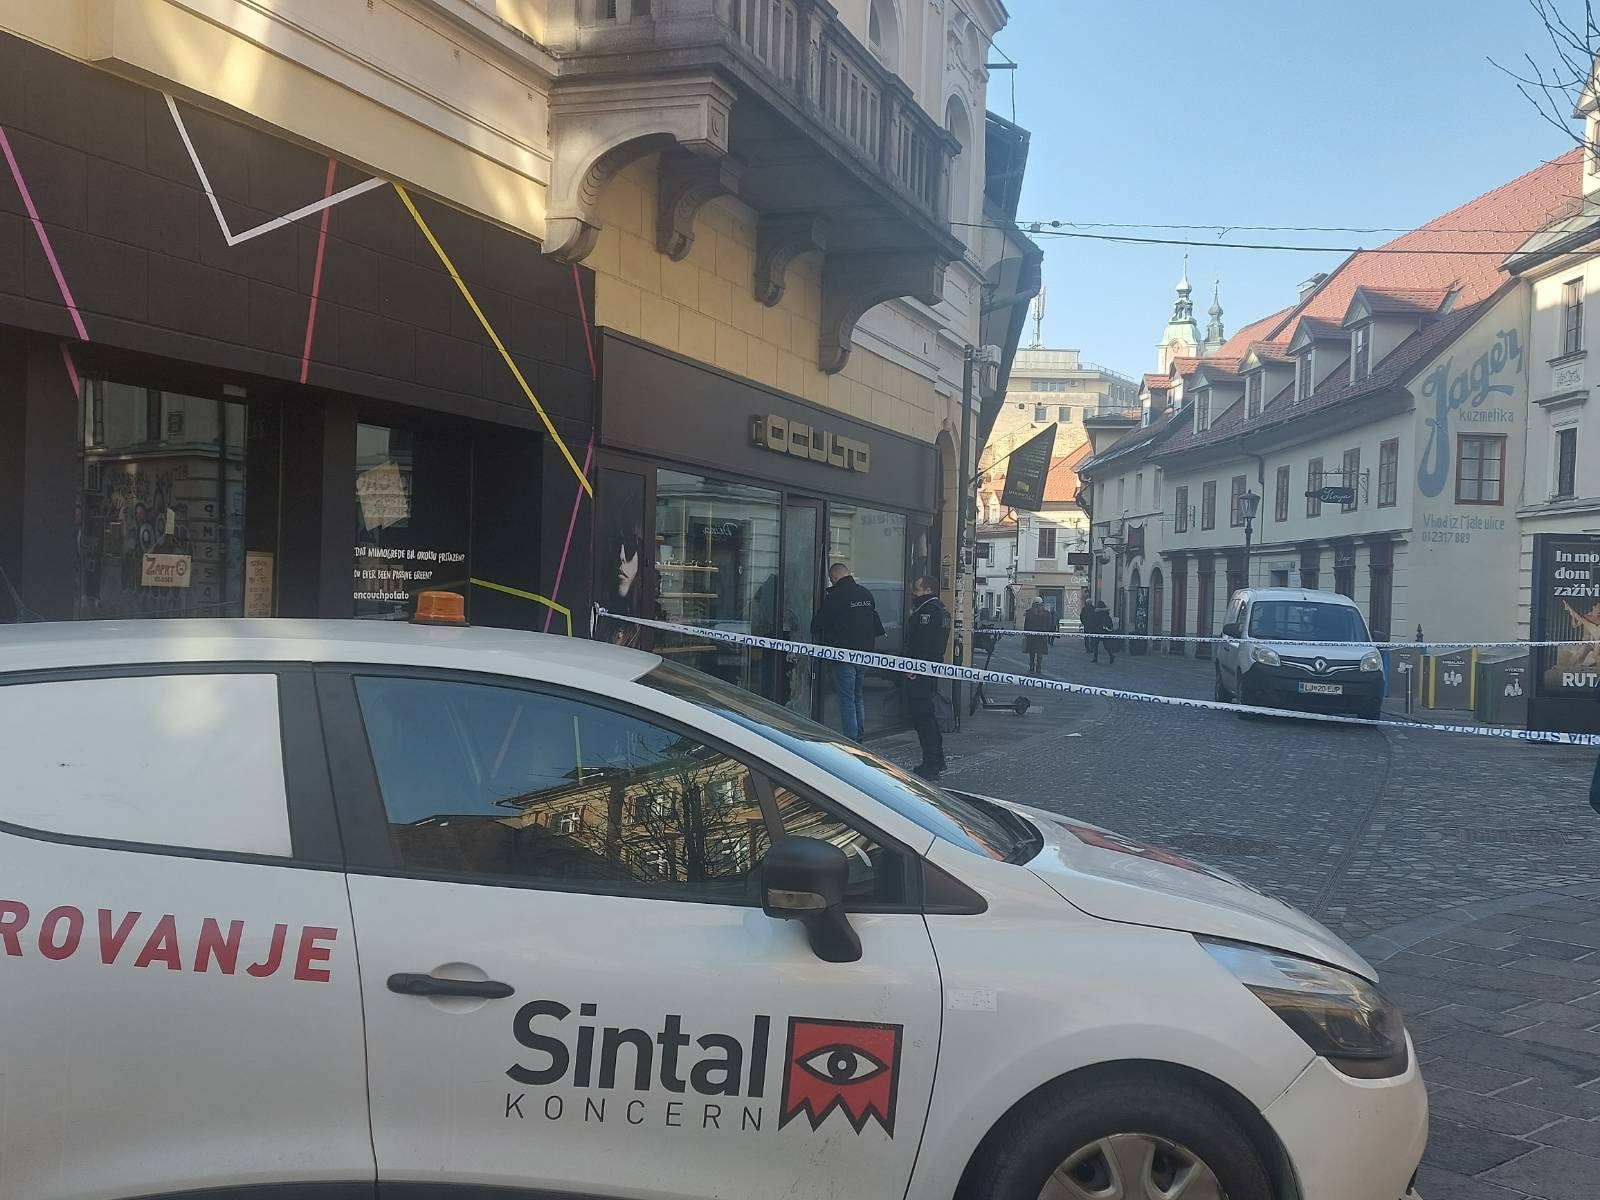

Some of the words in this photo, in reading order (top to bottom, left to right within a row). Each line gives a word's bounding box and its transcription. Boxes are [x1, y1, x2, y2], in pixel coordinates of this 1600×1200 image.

[1417, 328, 1524, 498] Jager
[1459, 407, 1514, 423] kozmetika
[762, 414, 871, 473] OCULTO
[1423, 513, 1448, 528] Vhod
[1484, 515, 1505, 529] ulice
[1555, 550, 1572, 562] In
[1554, 566, 1590, 580] dom
[1553, 583, 1600, 597] zaživi
[769, 640, 814, 656] POLICIJA
[817, 648, 845, 660] STOP
[848, 652, 896, 669] POLICIJA
[898, 660, 927, 673] STOP
[931, 664, 980, 680] POLICIJA
[982, 672, 1013, 684] STOP
[1562, 672, 1600, 687] RUT
[1018, 677, 1071, 693] POLICIJA
[0, 899, 338, 983] ROVANJE
[505, 999, 771, 1098] Sintal
[505, 1093, 762, 1131] KONCERN
